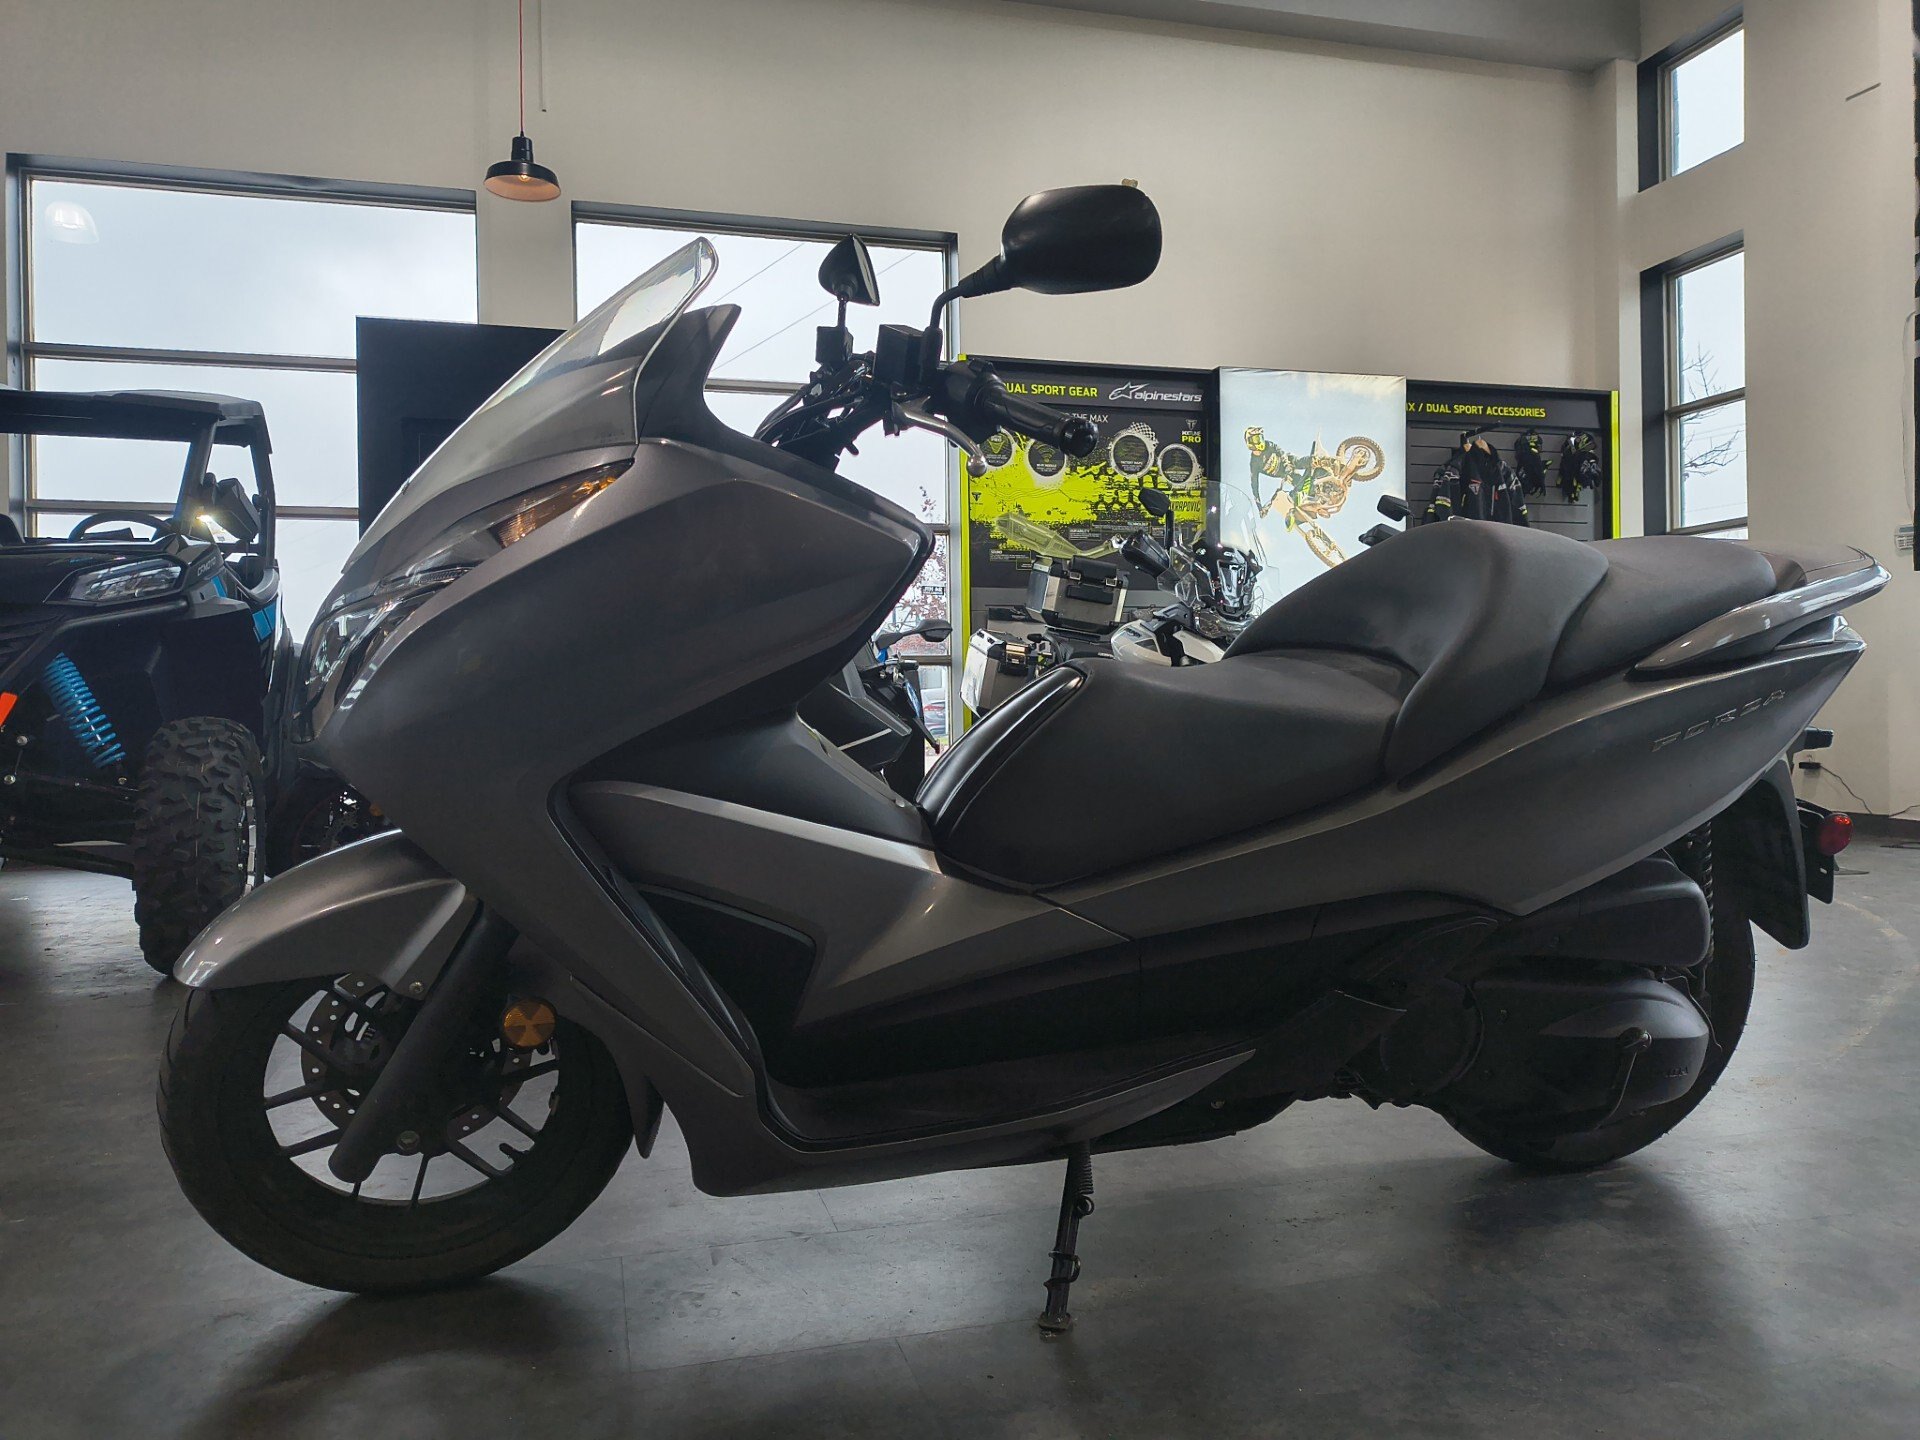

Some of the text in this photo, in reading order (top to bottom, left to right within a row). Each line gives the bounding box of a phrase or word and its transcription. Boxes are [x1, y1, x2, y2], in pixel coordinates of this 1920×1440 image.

[1003, 382, 1098, 397] UAL SPORT GEAR
[1134, 390, 1202, 402] alpinestars
[1426, 403, 1451, 413] DUAL
[1453, 404, 1484, 415] SPORT
[1486, 406, 1546, 418] ACCESSORIES
[1089, 414, 1109, 424] MAX
[1181, 435, 1202, 443] PRO
